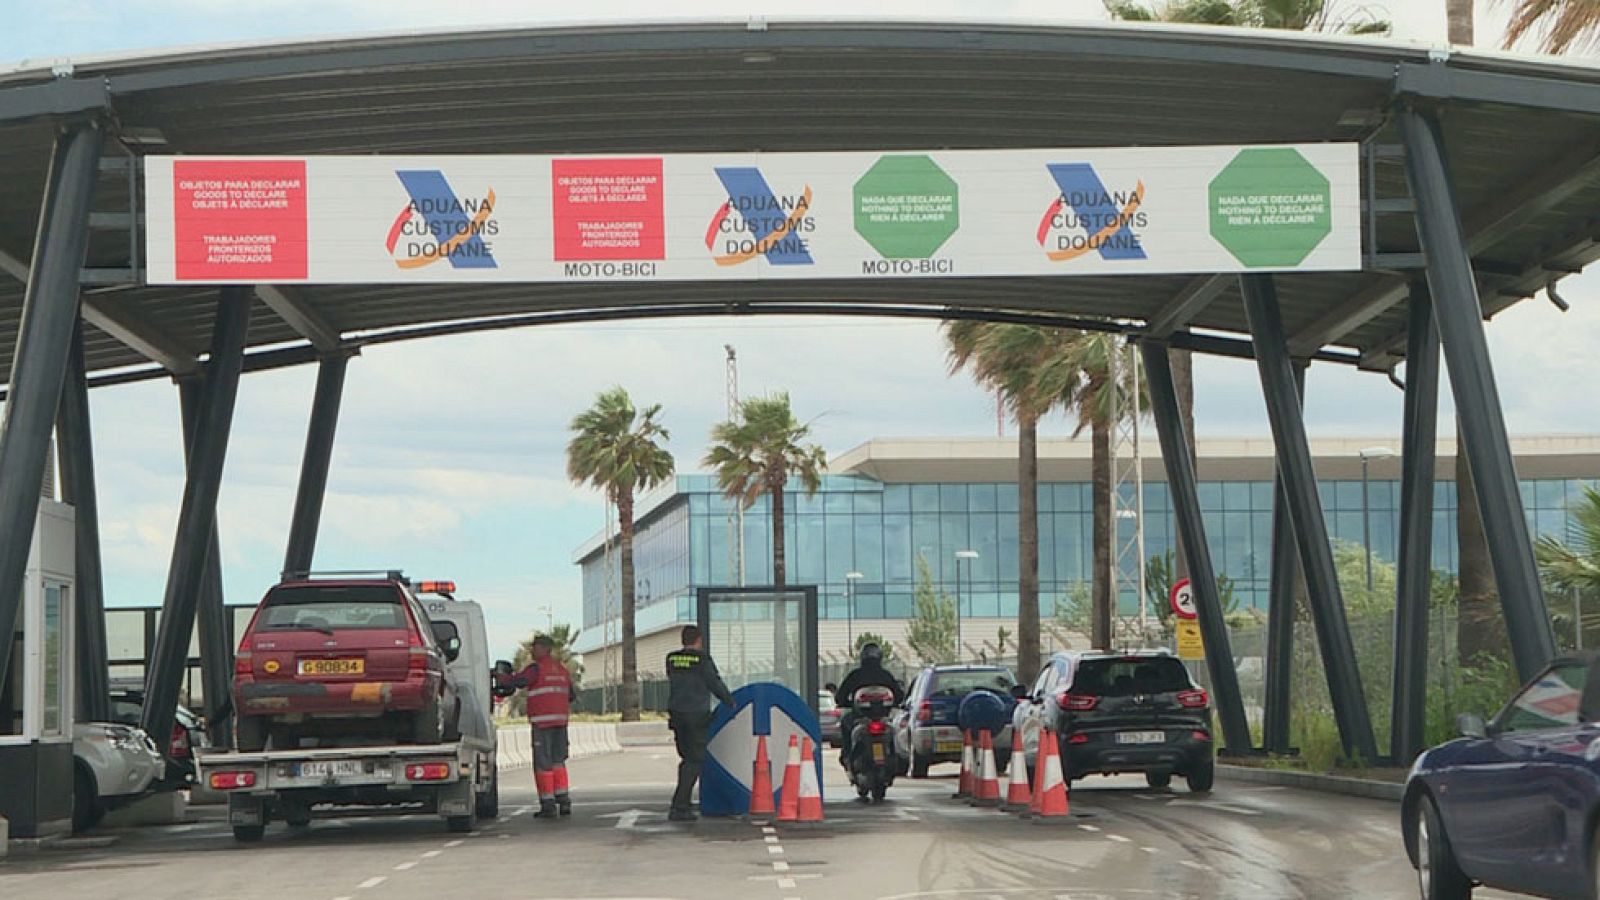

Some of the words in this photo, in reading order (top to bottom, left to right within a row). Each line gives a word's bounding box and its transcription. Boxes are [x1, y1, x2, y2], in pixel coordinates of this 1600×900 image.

[180, 180, 222, 189] OBJETOS
[224, 180, 249, 188] PARA
[251, 179, 300, 188] DECLARAR
[558, 177, 593, 185] OBJETOS
[594, 176, 614, 184] PARA
[616, 175, 657, 184] DECLARAR
[569, 185, 596, 193] GOODS
[599, 185, 609, 193] TO
[610, 185, 645, 193] DECLARE
[193, 190, 227, 199] GOODS
[230, 190, 242, 198] TO
[244, 190, 286, 198] DECLARE
[568, 194, 597, 202] OBJETS
[861, 196, 885, 204] NADA
[906, 195, 953, 203] DECLARAR
[1057, 190, 1141, 206] ADUANA
[1219, 196, 1246, 205] NADA
[1247, 195, 1268, 204] QUE
[1270, 194, 1323, 203] DECLARAR
[192, 200, 228, 208] OBJETS
[408, 198, 493, 213] ADUANA
[726, 195, 809, 211] ADUANA
[861, 205, 899, 213] NOTHING
[900, 204, 911, 212] TO
[913, 204, 953, 212] DECLARE
[1218, 205, 1262, 215] NOTHING
[1264, 204, 1277, 214] TO
[1279, 204, 1324, 214] DECLARE
[870, 213, 891, 221] RIEN
[1051, 212, 1149, 228] CUSTOMS
[1228, 216, 1251, 225] RIEN
[401, 220, 499, 236] CUSTOMS
[578, 222, 643, 230] TRABAJADORES
[719, 216, 816, 233] CUSTOMS
[203, 235, 276, 243] TRABAJADORES
[582, 239, 640, 247] AUTORIZADOS
[1057, 234, 1142, 250] DOUANE
[208, 245, 272, 253] FRONTERIZOS
[407, 242, 494, 258] DOUANE
[726, 239, 809, 254] DOUANE
[207, 254, 272, 262] AUTORIZADOS
[564, 263, 656, 277] MOTO-BICI
[862, 260, 953, 274] MOTO-BICI
[429, 603, 446, 613] 05
[303, 660, 313, 673] G
[315, 660, 358, 673] 90834
